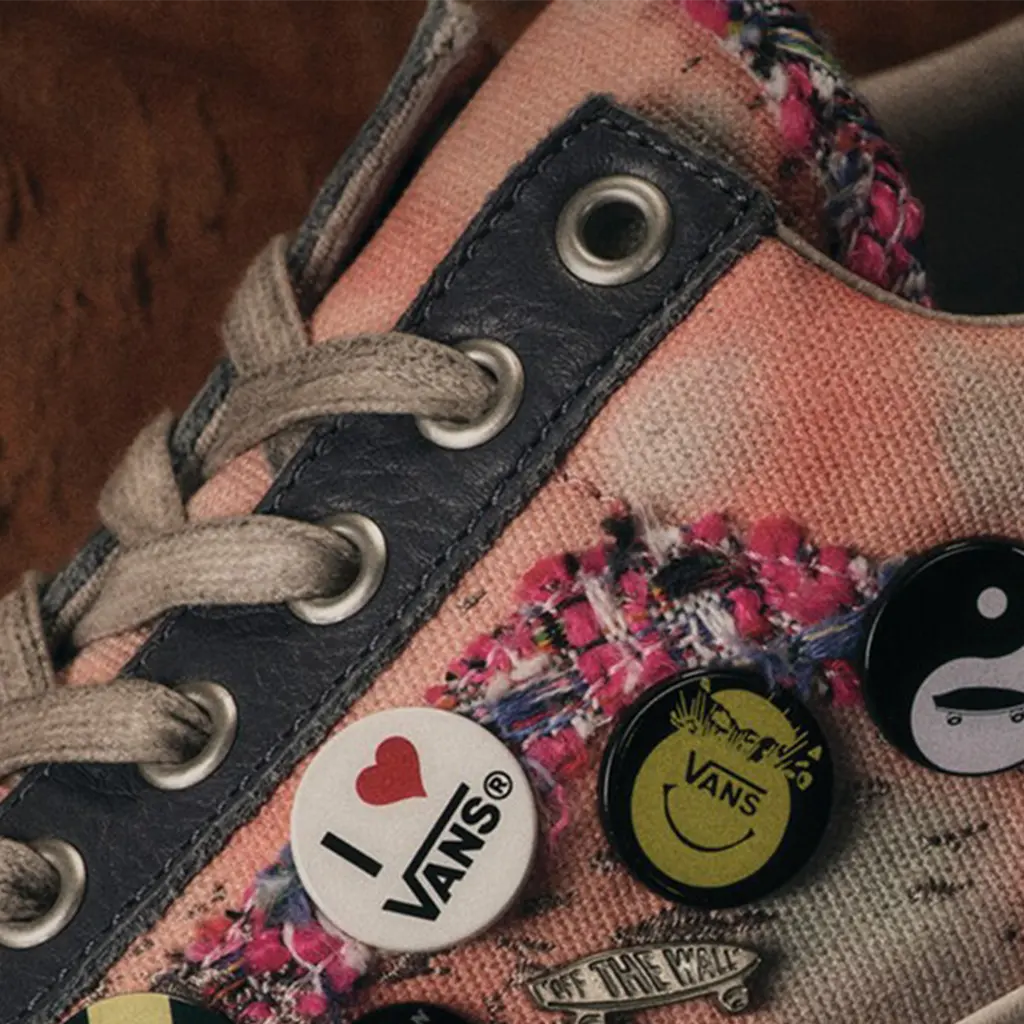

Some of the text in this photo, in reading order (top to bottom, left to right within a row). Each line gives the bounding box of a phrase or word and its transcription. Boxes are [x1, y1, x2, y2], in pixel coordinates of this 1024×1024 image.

[685, 750, 768, 816] VANS
[320, 831, 383, 878] I
[588, 950, 672, 998] THE
